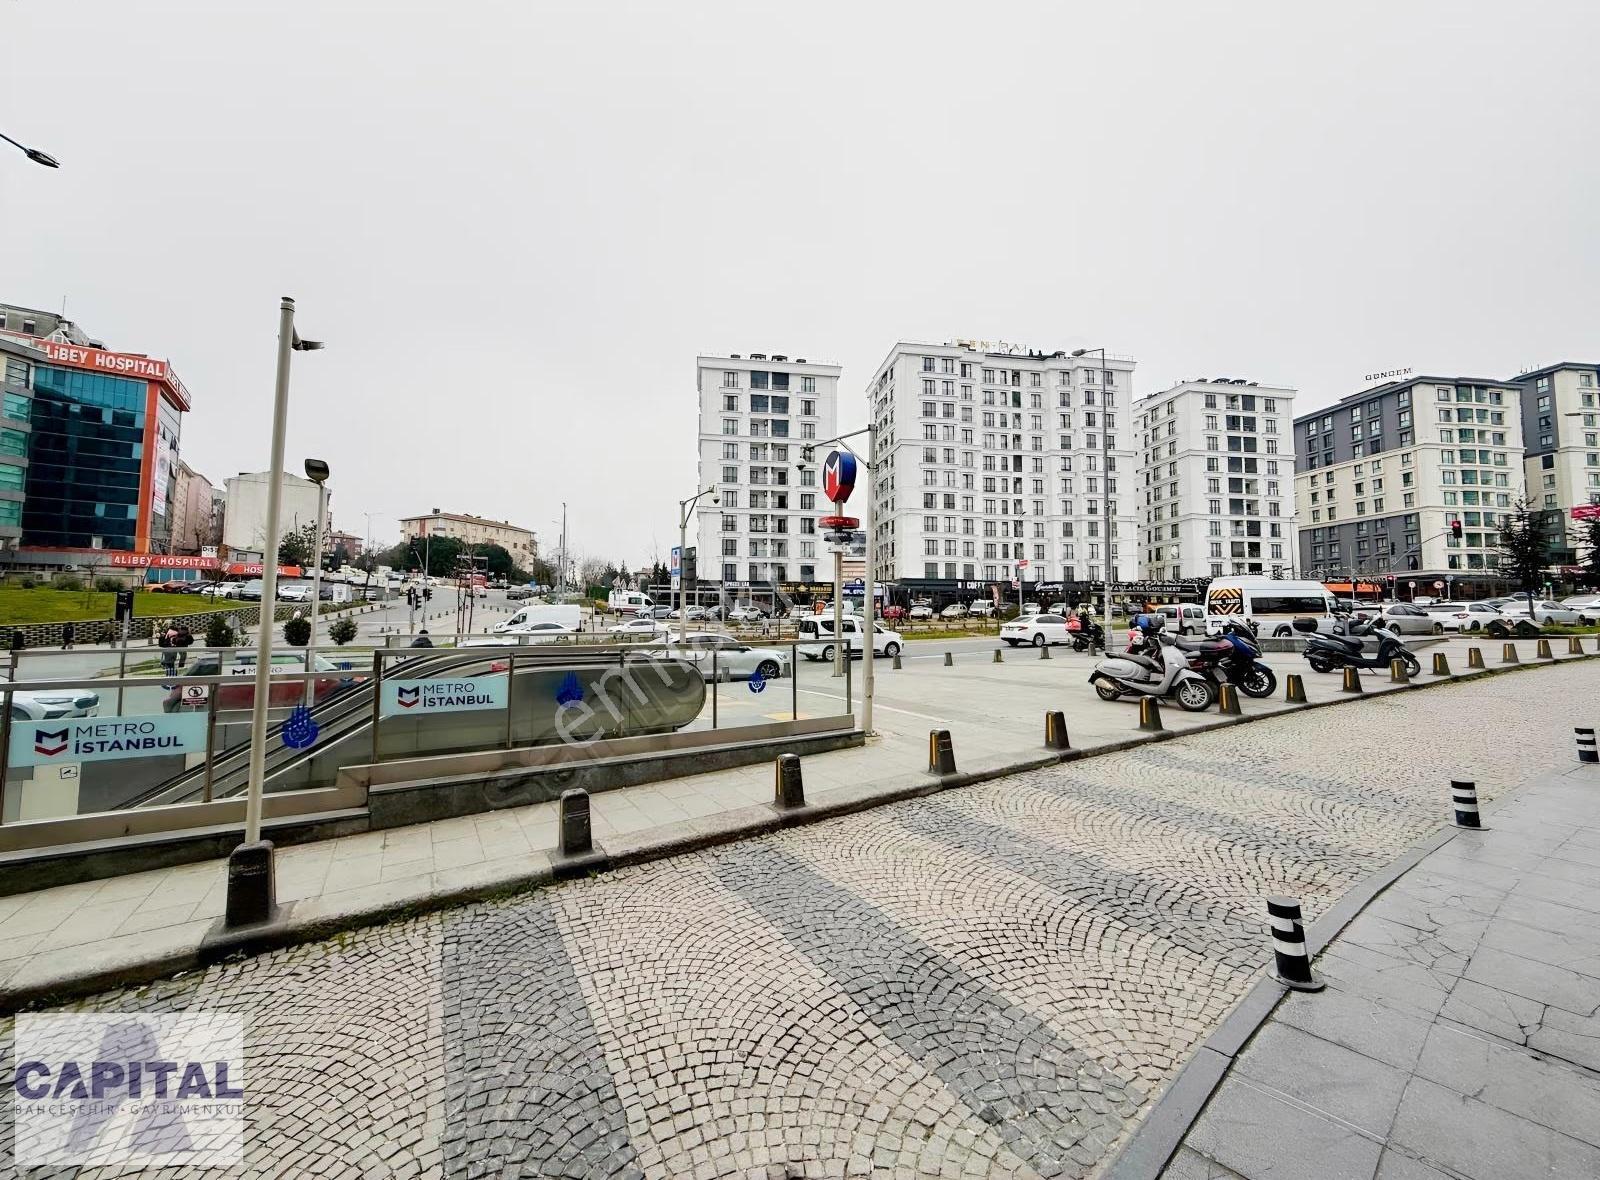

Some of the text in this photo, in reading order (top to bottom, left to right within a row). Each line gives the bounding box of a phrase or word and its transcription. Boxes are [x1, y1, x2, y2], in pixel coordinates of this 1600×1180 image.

[45, 344, 163, 376] LİBEY HOSPITAL
[160, 557, 212, 568] HOSPITAL
[244, 565, 288, 575] HOSAL
[423, 682, 475, 695] METRO
[423, 694, 494, 708] İSTANBUL
[76, 721, 155, 738] METRO
[74, 735, 184, 755] İSTANBUL
